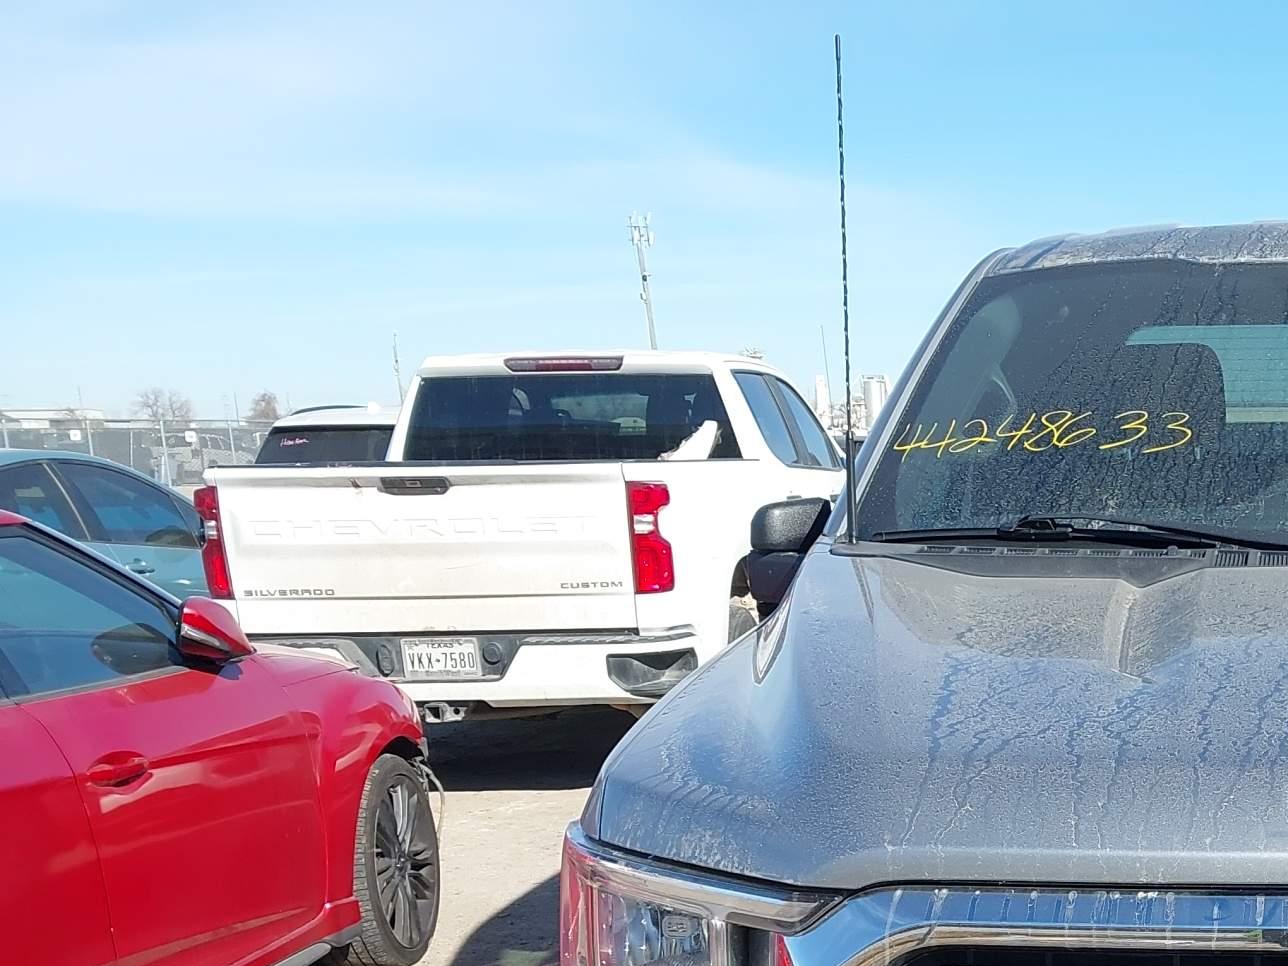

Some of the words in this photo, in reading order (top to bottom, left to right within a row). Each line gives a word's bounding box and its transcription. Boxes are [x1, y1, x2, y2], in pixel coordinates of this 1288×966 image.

[893, 410, 1192, 462] 44248633
[246, 514, 597, 537] CHEVROLET
[243, 587, 336, 597] SILVERADO
[560, 581, 624, 590] CUSTOM
